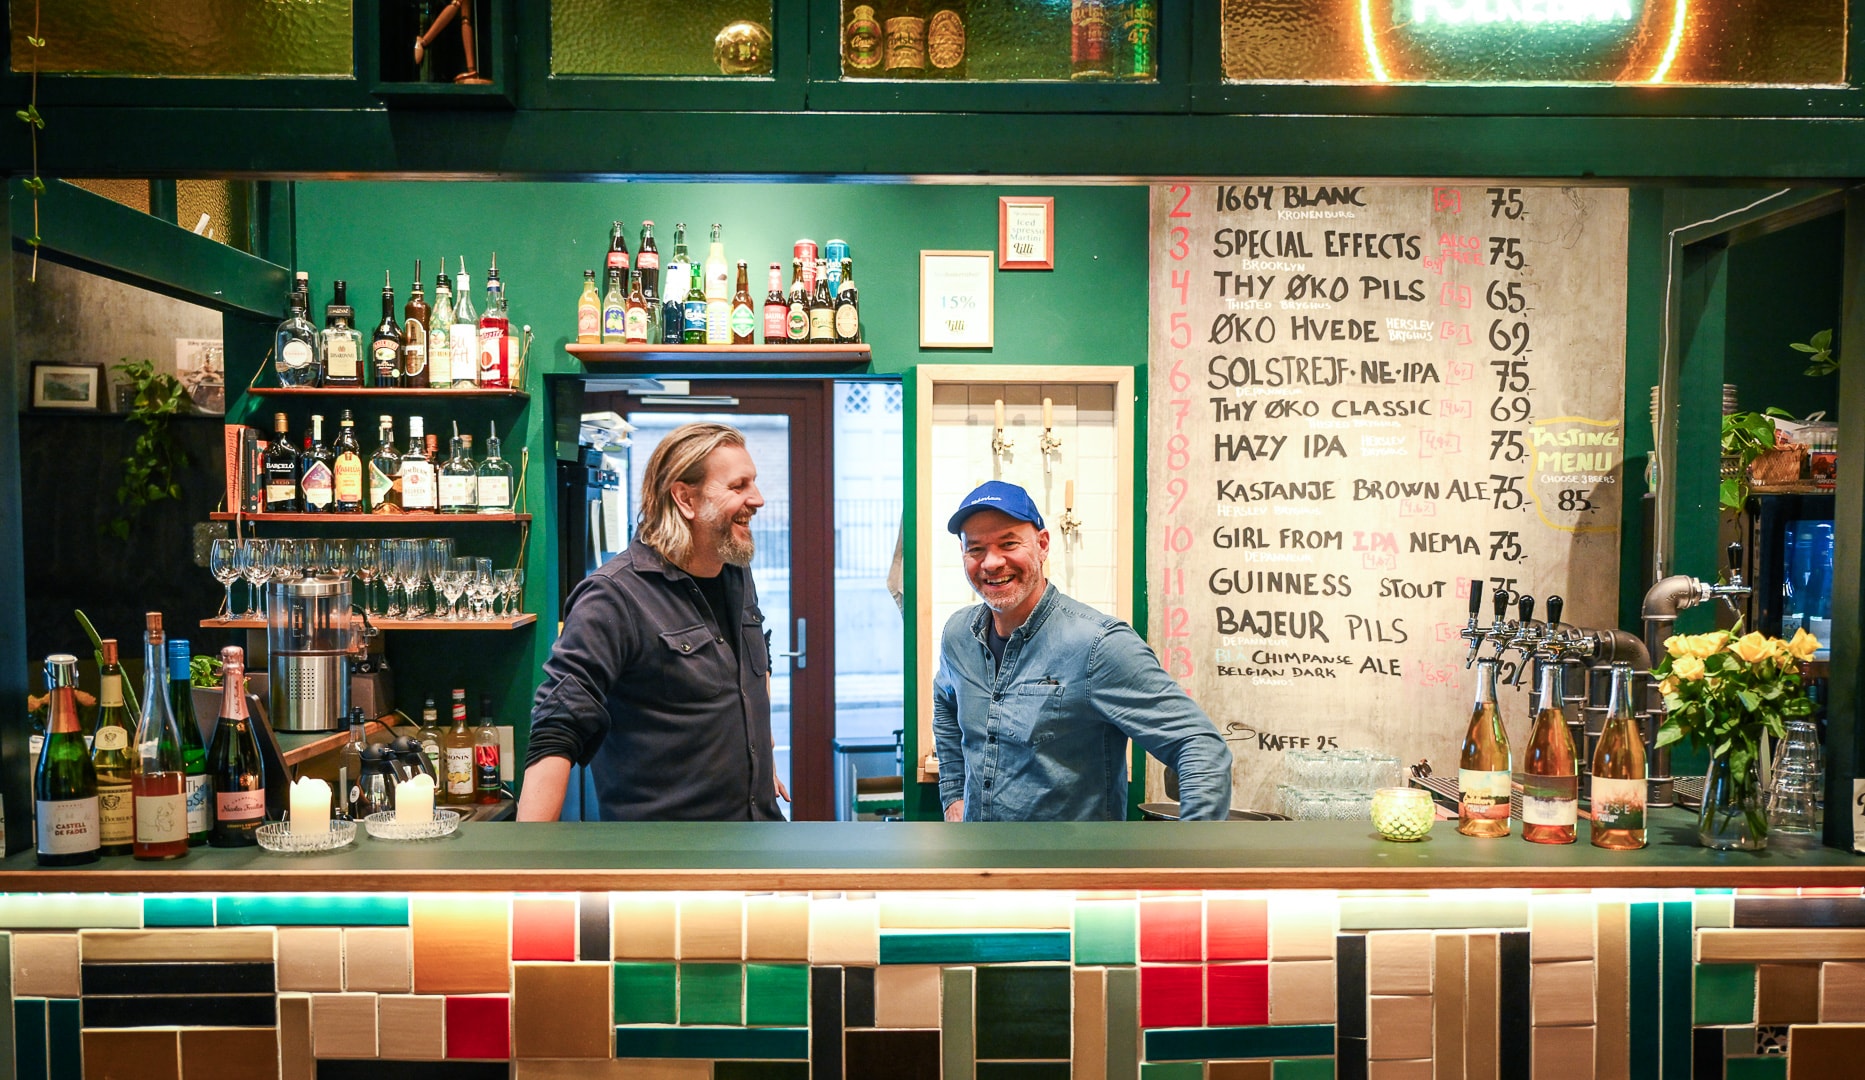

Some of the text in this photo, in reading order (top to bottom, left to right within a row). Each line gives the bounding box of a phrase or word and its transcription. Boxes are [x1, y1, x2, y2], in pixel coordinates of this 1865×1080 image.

[1169, 185, 1192, 218] 2
[1216, 186, 1274, 212] 1664
[1282, 186, 1367, 209] BLANC
[1277, 209, 1356, 220] KRONENBURG
[1169, 226, 1422, 261] 3 SPECIAL EFFECTS
[1437, 232, 1481, 250] ALCO
[1242, 259, 1305, 272] BROOKLYN
[1171, 270, 1190, 306] 4
[1213, 271, 1276, 301] THY
[1284, 273, 1350, 303] ØKO
[1358, 275, 1426, 302] PILS
[1224, 298, 1333, 311] THISTED BRYGHUS
[1169, 312, 1380, 350] 5 ØKO HVEDE
[1386, 317, 1434, 331] HERSLEV
[1388, 328, 1434, 343] BRYGHUS
[1169, 359, 1191, 393] 6
[1169, 399, 1191, 431] 7
[1209, 397, 1258, 423] THY
[1264, 398, 1320, 420] ØKO
[1331, 399, 1433, 420] CLASSIC
[1528, 426, 1620, 447] TASTING
[1167, 434, 1348, 471] 8 HAZY IPA
[1536, 451, 1613, 474] MENU
[1539, 474, 1580, 485] CHOOSE
[1166, 477, 1189, 516] 9
[1216, 479, 1337, 502] KASTANJE
[1352, 478, 1440, 502] BROWN
[1445, 478, 1491, 503] ALE
[1163, 525, 1194, 553] 10
[1212, 525, 1271, 550] GIRL
[1279, 527, 1344, 551] FROM
[1351, 530, 1401, 555] IPA
[1408, 530, 1481, 556] NEMA
[1163, 567, 1186, 596] 11
[1208, 567, 1353, 597] GUINNESS
[1379, 577, 1447, 600] STOUT
[1163, 606, 1191, 639] 12
[1215, 605, 1330, 644] BAJEUR
[1344, 614, 1409, 644] PILS
[1217, 664, 1285, 678] BELGIAN
[1291, 665, 1337, 679] DARK
[1252, 649, 1354, 666] CHIMPANSE
[1359, 655, 1402, 678] ALE
[55, 828, 88, 837] DE FADES
[56, 821, 87, 830] CASTELL
